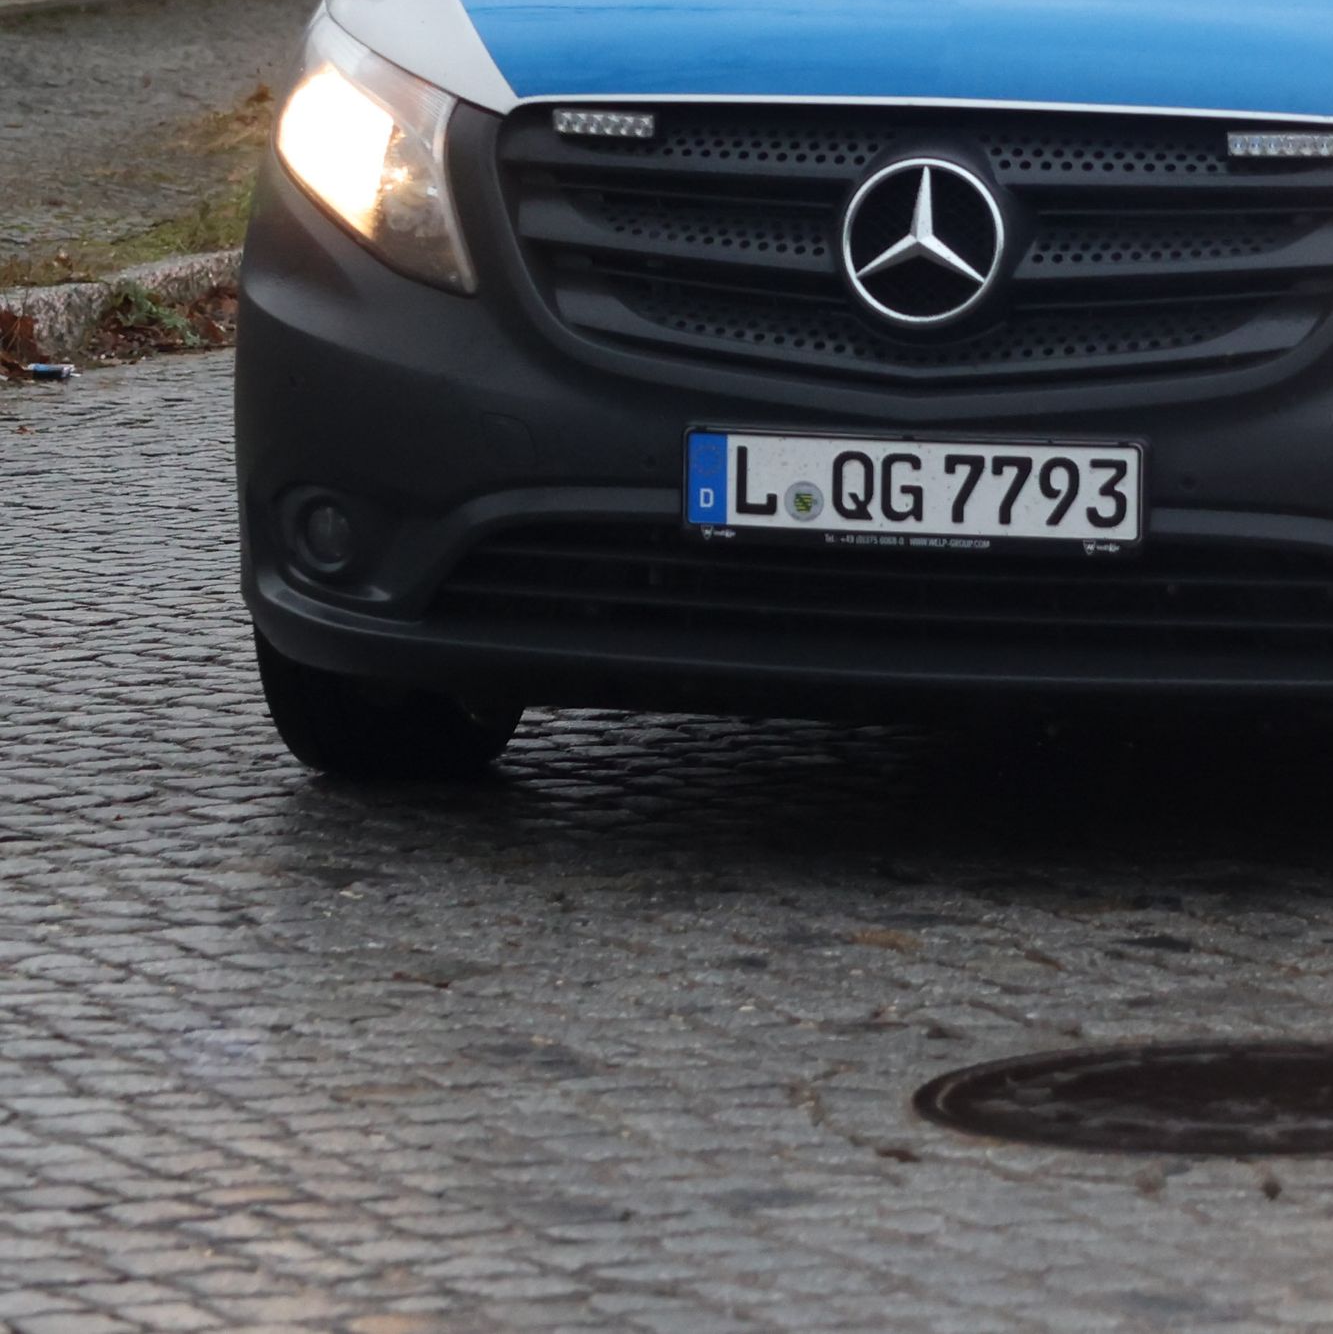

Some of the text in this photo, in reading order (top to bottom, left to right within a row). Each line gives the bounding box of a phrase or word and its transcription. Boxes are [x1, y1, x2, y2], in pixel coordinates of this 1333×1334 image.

[700, 488, 714, 508] D
[736, 446, 1128, 529] L QG 7793
